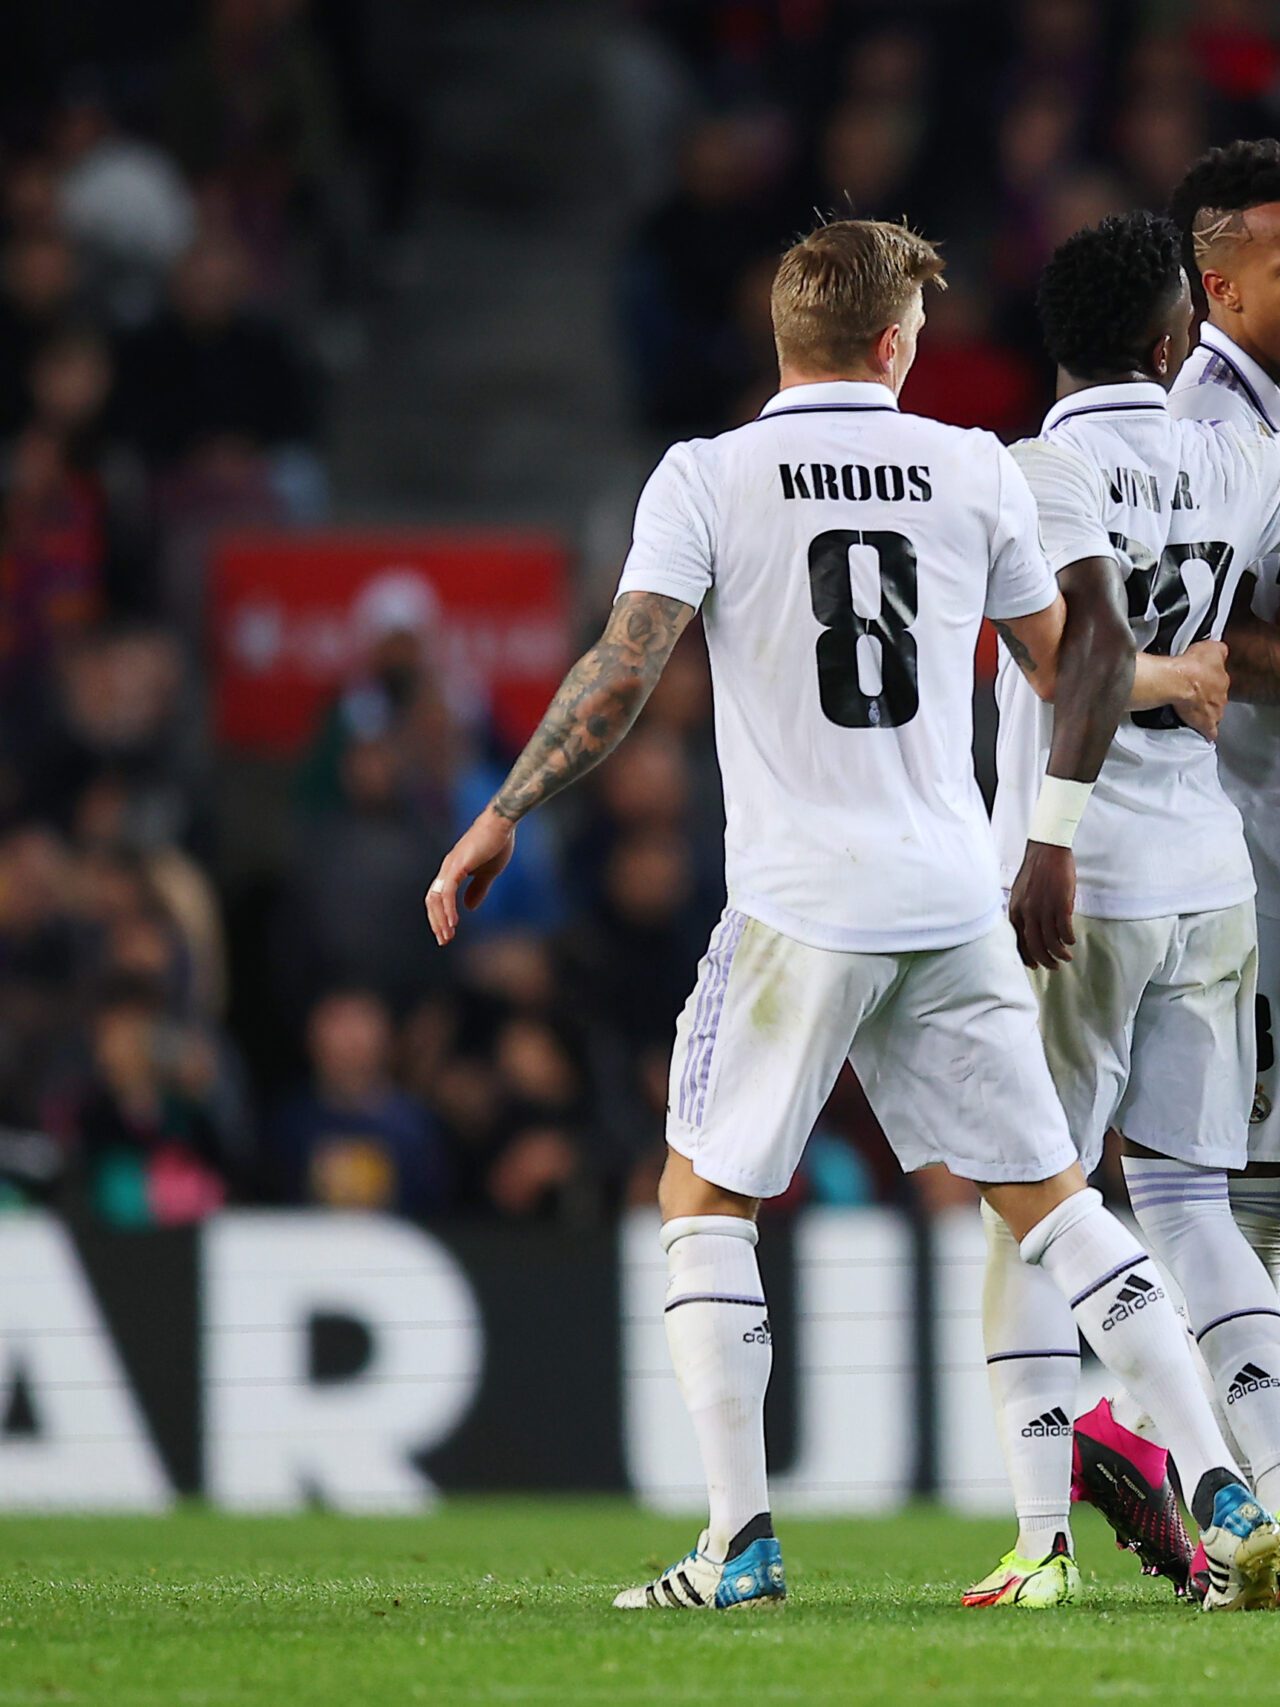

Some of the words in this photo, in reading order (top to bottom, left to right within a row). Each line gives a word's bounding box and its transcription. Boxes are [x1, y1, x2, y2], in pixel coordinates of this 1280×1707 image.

[779, 463, 933, 502] KROOS
[807, 528, 919, 729] 8
[1102, 1287, 1165, 1332] adidas
[0, 1208, 486, 1516] AR
[1226, 1377, 1280, 1405] adidas
[1021, 1425, 1074, 1438] adidas
